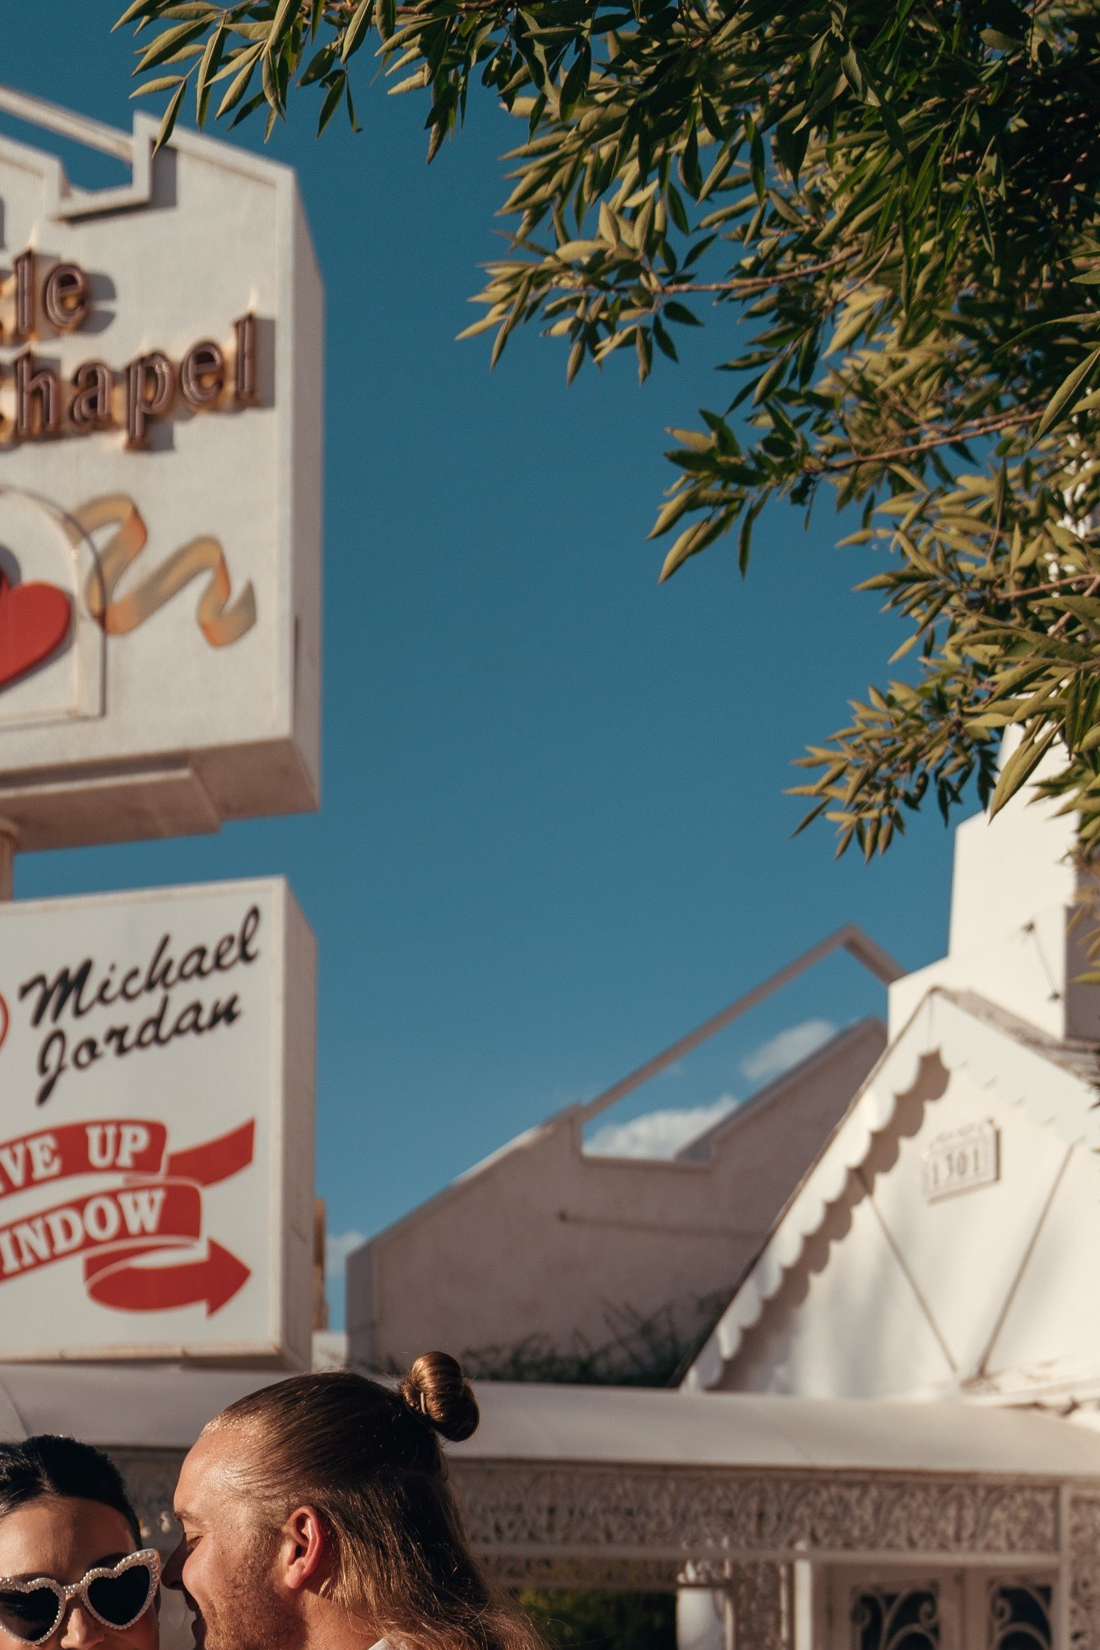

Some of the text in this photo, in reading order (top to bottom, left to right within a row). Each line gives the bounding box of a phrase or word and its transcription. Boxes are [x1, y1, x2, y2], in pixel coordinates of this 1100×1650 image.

[18, 905, 260, 1028] Michael
[36, 990, 243, 1105] Jordan
[85, 1122, 150, 1169] UP
